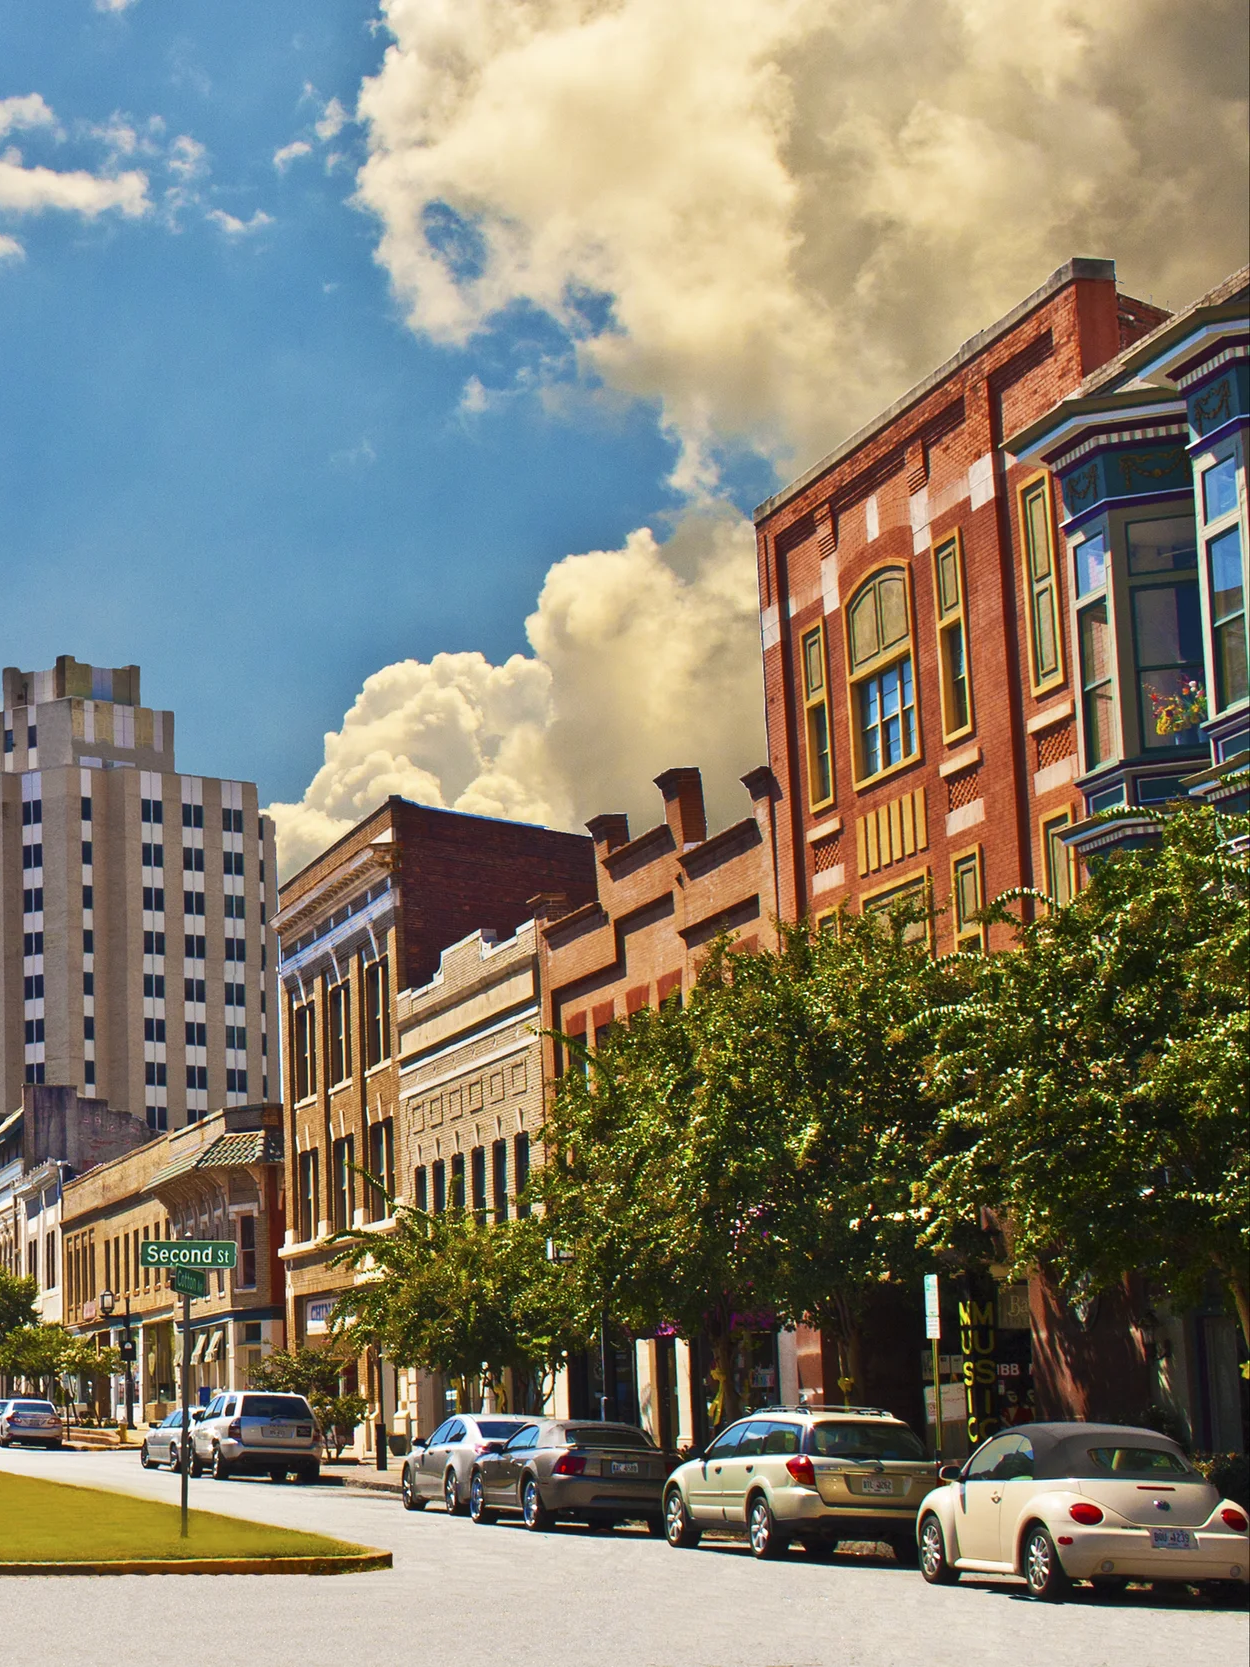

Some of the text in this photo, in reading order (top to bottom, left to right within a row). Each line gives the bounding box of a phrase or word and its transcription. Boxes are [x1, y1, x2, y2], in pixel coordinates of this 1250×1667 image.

[147, 1245, 230, 1263] Second St
[177, 1269, 197, 1291] Cotton
[958, 1300, 978, 1443] MUSIC
[972, 1301, 998, 1440] MUSIC
